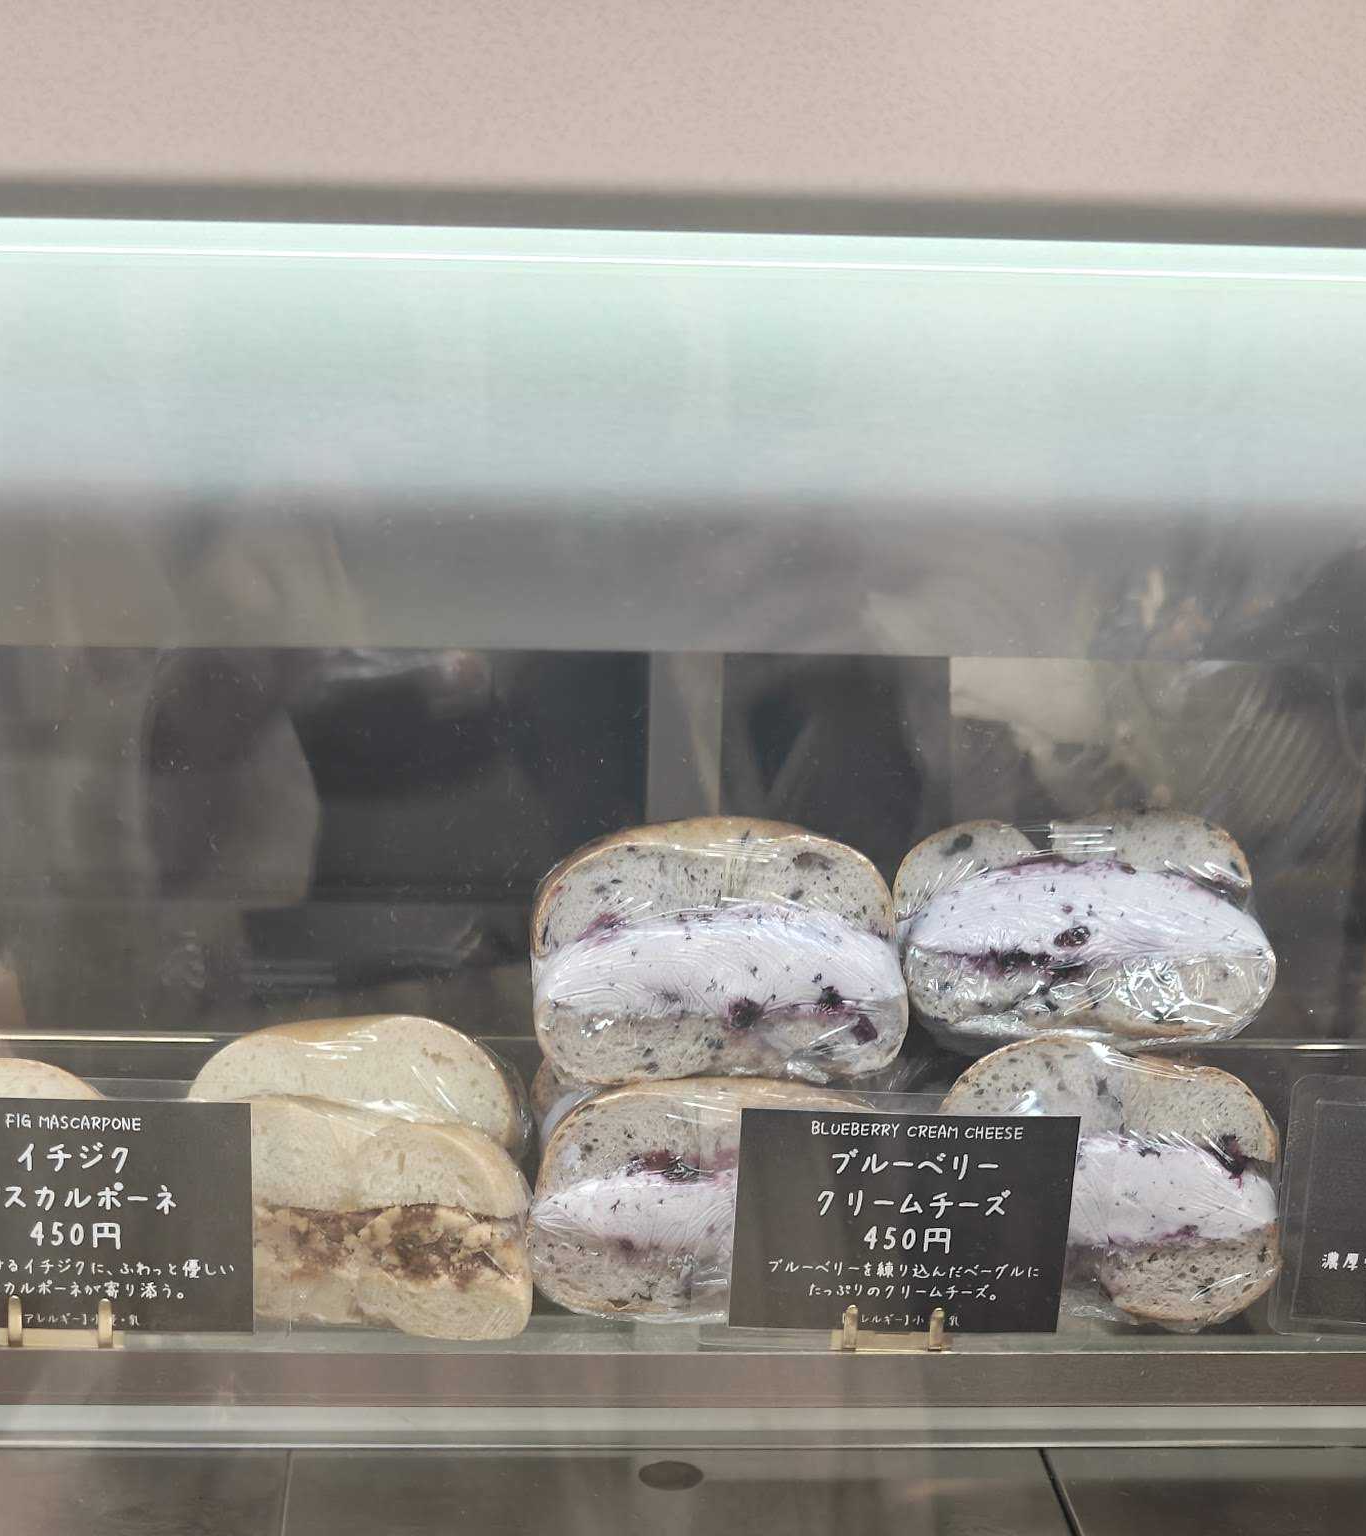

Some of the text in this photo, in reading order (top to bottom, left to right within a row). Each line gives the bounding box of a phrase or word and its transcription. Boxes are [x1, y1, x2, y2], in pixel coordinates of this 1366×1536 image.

[5, 1112, 142, 1132] FIG MASCARPONE
[811, 1120, 1024, 1141] BLUEBERRY CREAM CHEESE
[17, 1142, 129, 1173] イチジク
[831, 1148, 999, 1180] ブルーベリー
[817, 1189, 1012, 1219] クリームチーズ
[30, 1221, 121, 1250] 450円
[863, 1225, 952, 1254] 450円
[768, 1258, 1043, 1281] ブルーベリーを練り込んだベーグルに
[808, 1283, 997, 1301] たっぷりのクリームチーズ。
